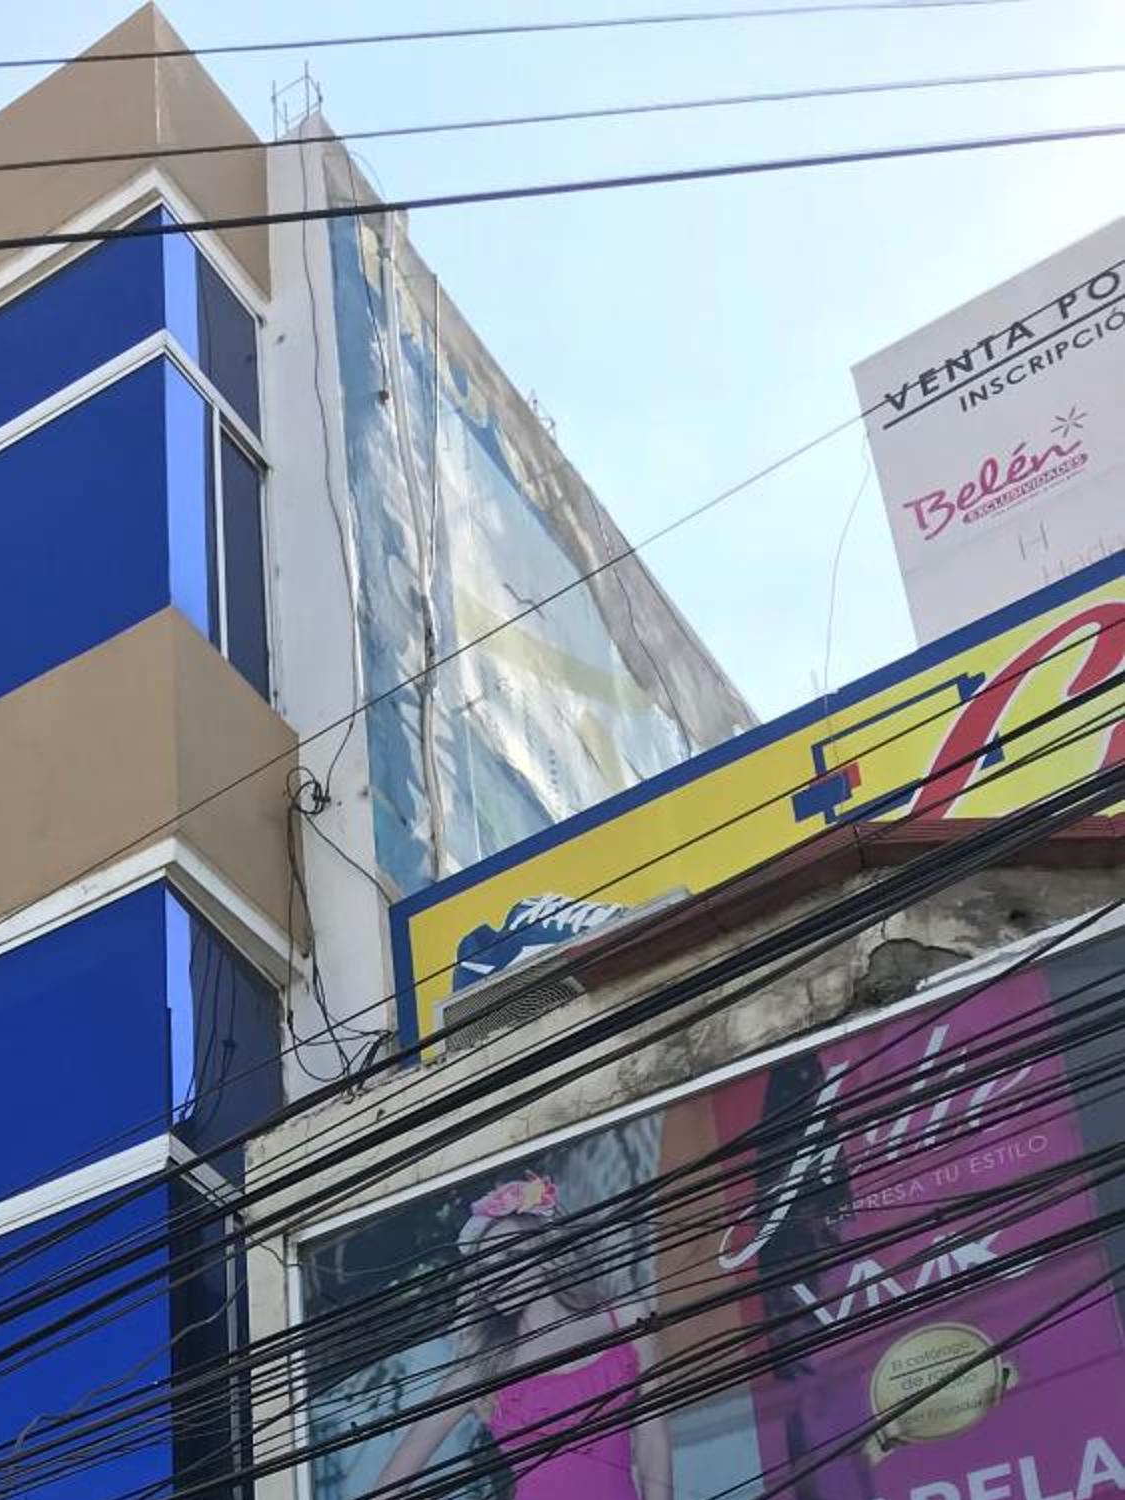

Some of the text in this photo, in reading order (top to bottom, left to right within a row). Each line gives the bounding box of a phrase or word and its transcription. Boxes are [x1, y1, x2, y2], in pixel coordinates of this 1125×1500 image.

[884, 269, 1123, 412] VENTA PO
[903, 441, 1082, 540] Belén
[932, 1166, 960, 1187] TU
[970, 1135, 1049, 1174] ESTILO
